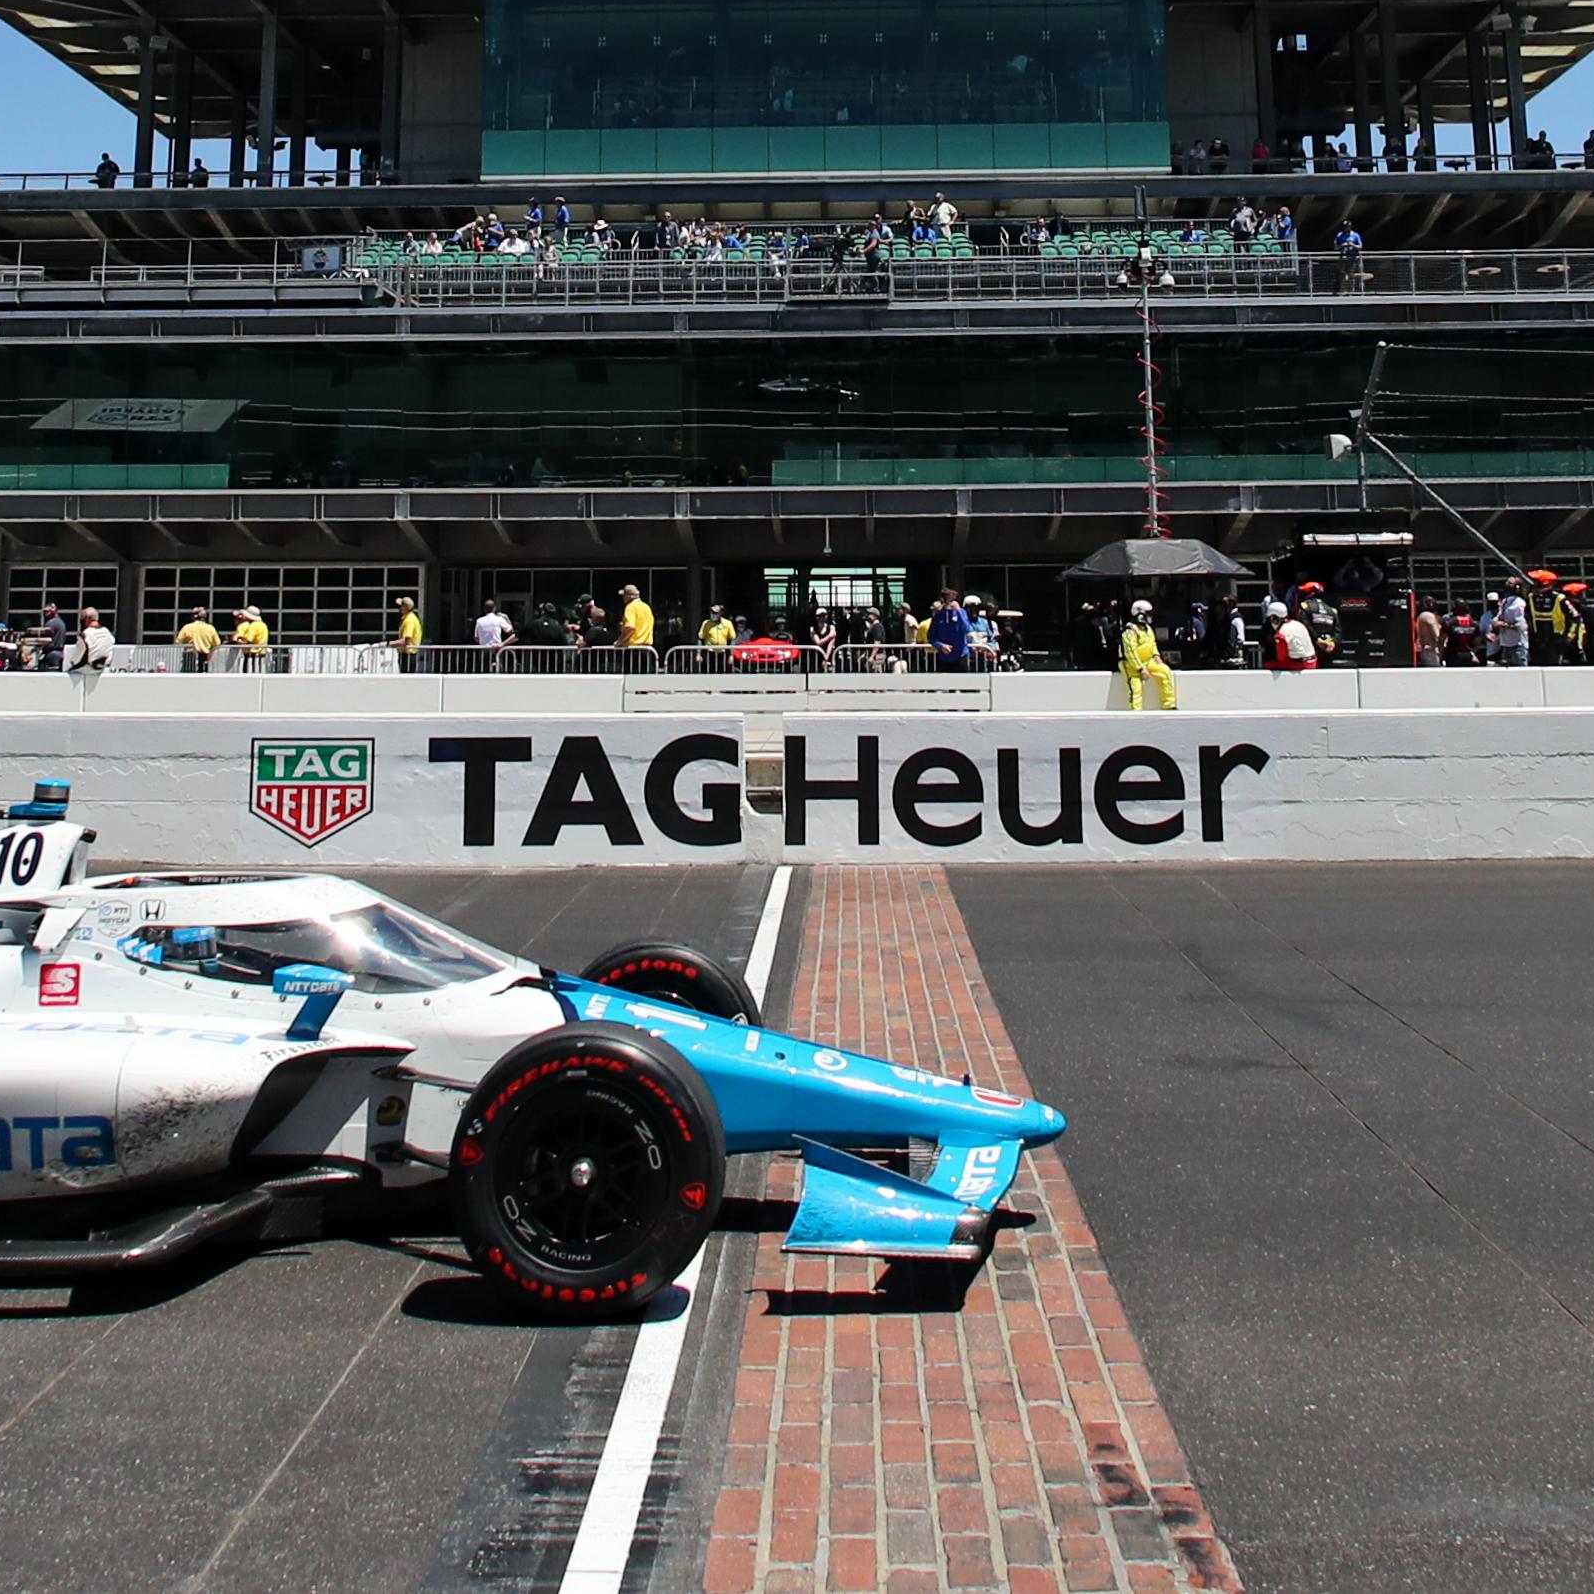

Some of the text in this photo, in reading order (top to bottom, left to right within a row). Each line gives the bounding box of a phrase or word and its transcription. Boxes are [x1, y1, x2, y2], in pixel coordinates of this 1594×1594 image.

[262, 748, 362, 778] TAG
[259, 785, 366, 833] HEUER
[260, 1036, 344, 1062] Firestone
[484, 1055, 630, 1122] FIREHAWK
[539, 1243, 593, 1262] RACING
